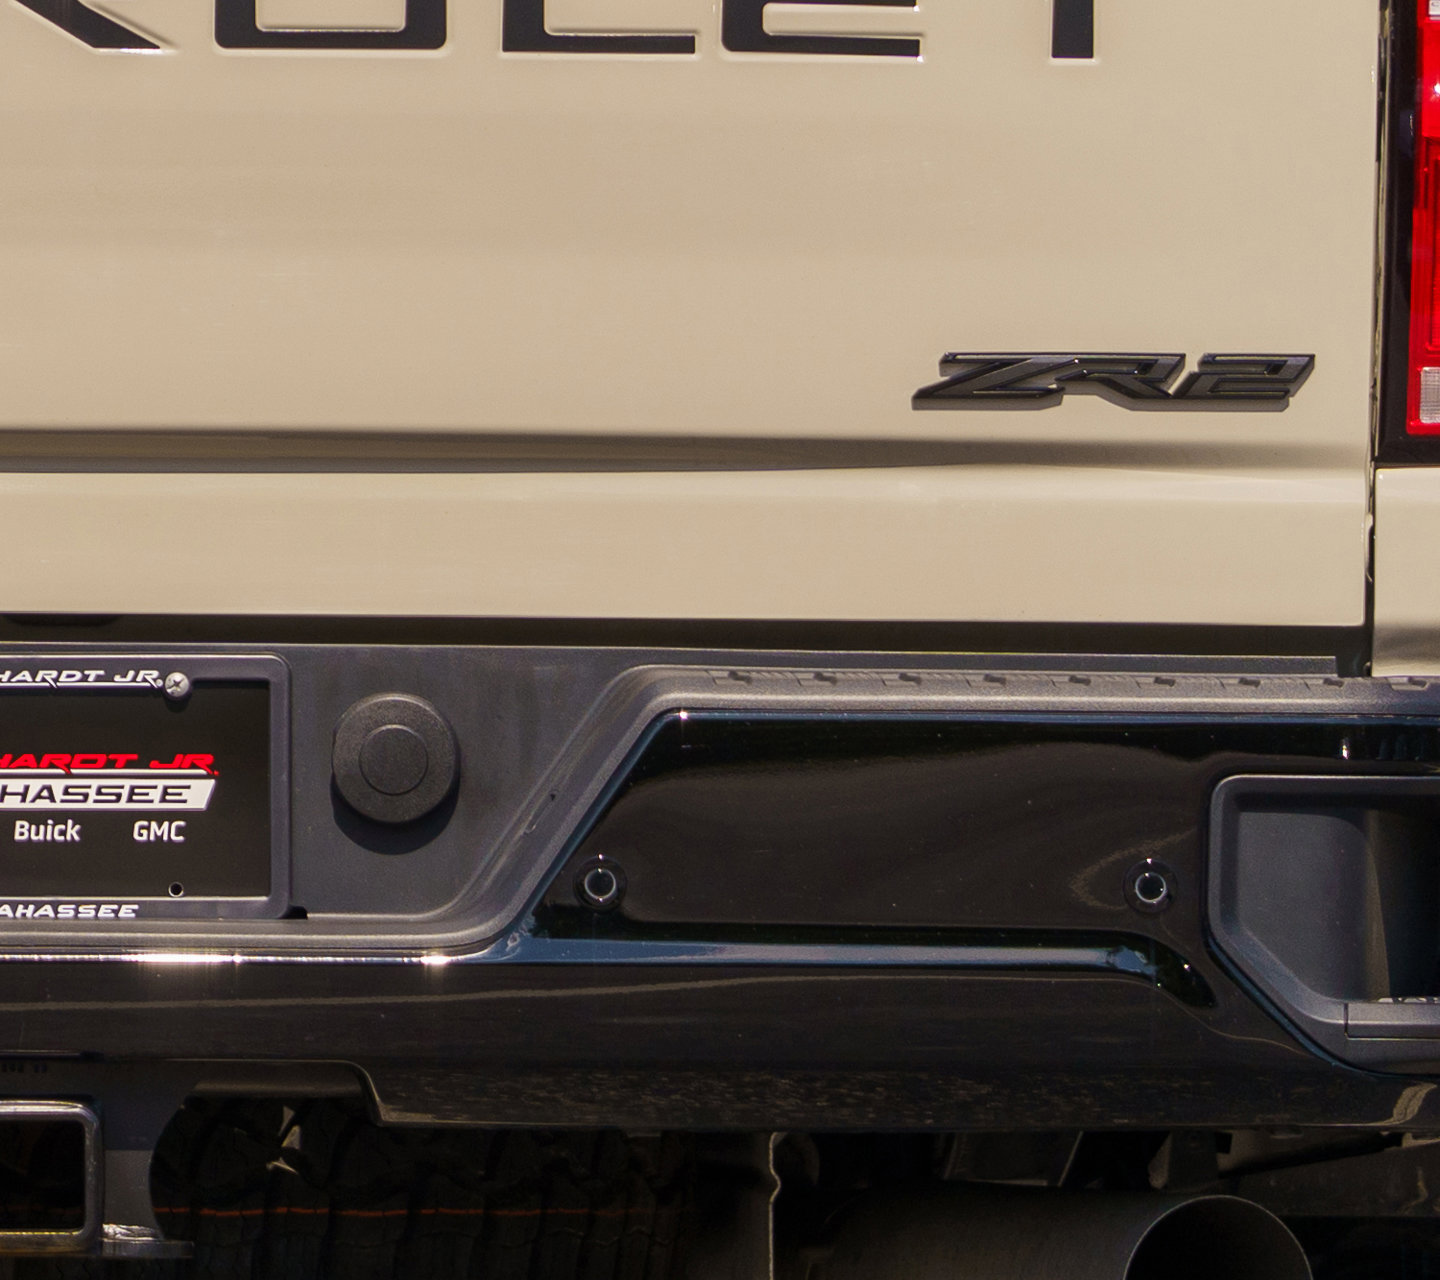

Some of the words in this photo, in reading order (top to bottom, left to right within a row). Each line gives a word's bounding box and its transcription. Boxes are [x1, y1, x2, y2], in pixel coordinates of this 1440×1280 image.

[911, 352, 1316, 412] ZR2
[148, 753, 220, 776] JR.
[13, 819, 82, 842] Buick
[132, 820, 187, 842] GMC
